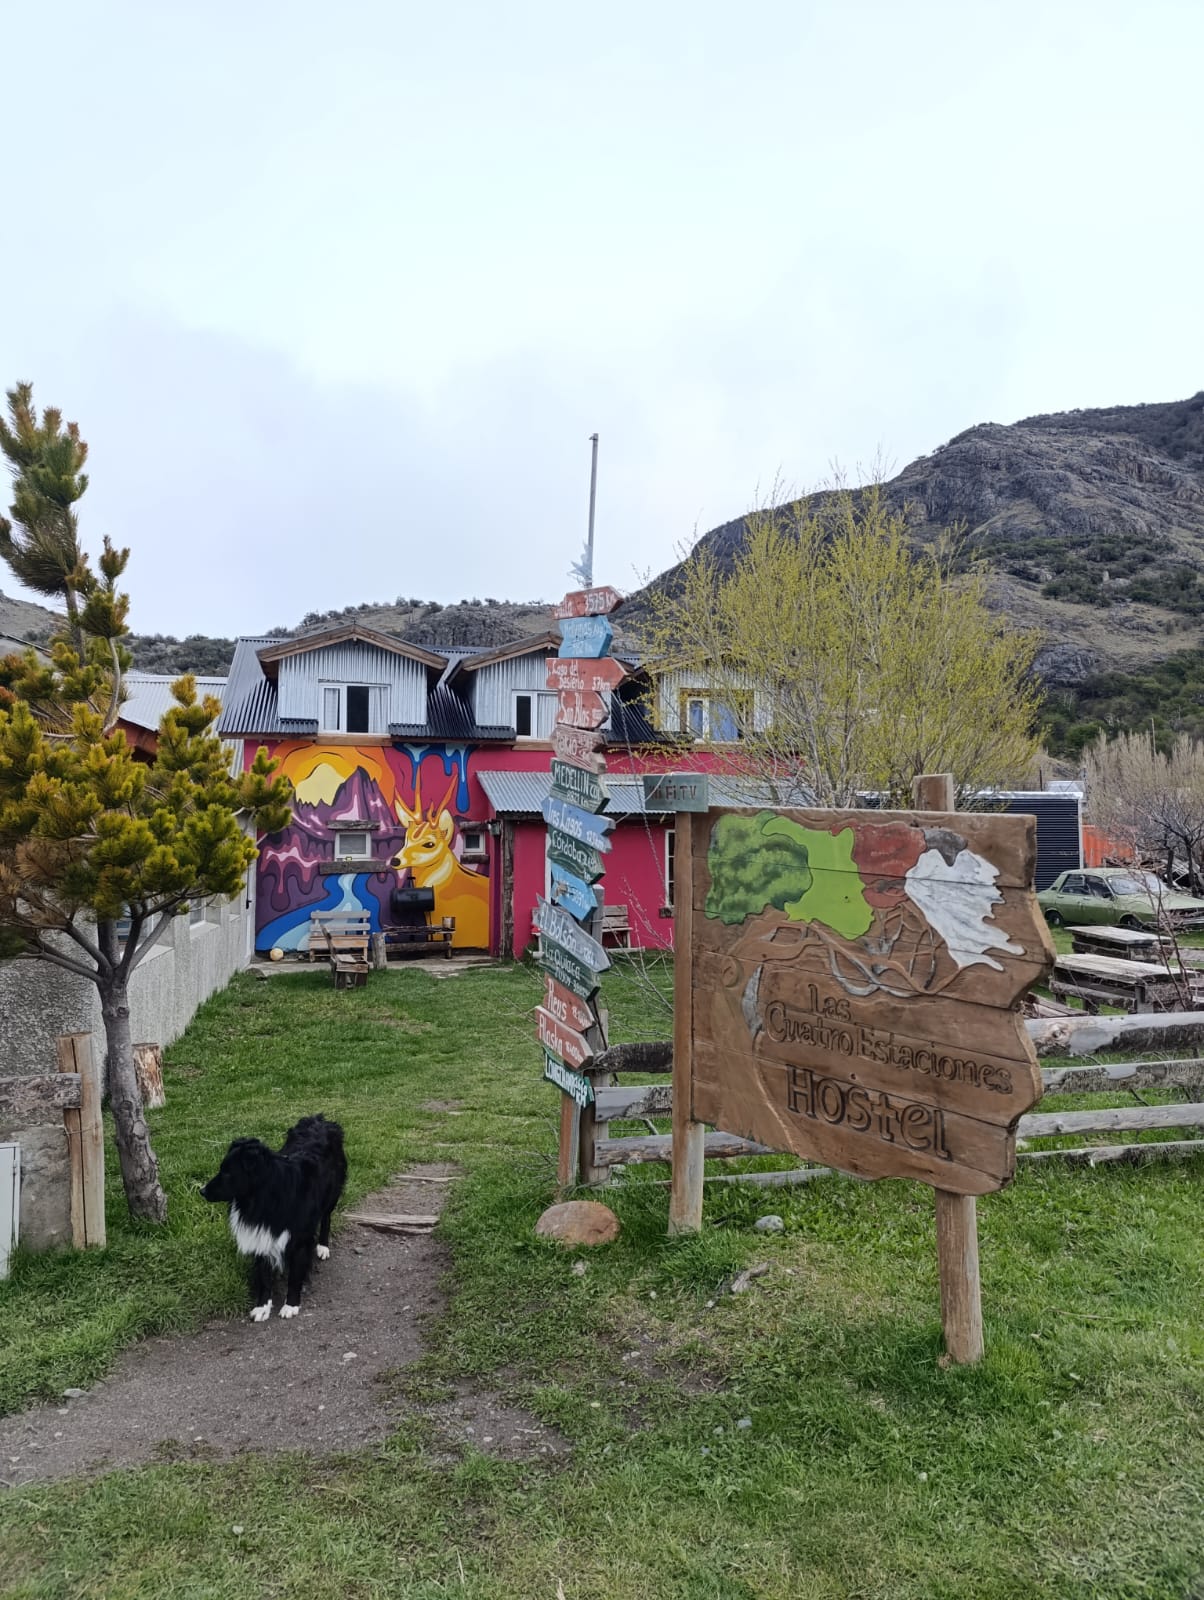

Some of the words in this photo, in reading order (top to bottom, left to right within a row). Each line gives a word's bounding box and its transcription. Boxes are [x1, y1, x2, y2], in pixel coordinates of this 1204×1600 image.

[552, 660, 568, 677] Lago
[548, 798, 560, 827] Tres
[560, 803, 583, 838] Lagos
[549, 911, 578, 950] Bolsón
[548, 978, 567, 1021] Reus
[808, 983, 851, 1021] Las
[764, 1000, 854, 1056] Cuatro
[855, 1022, 1013, 1094] Estaciones
